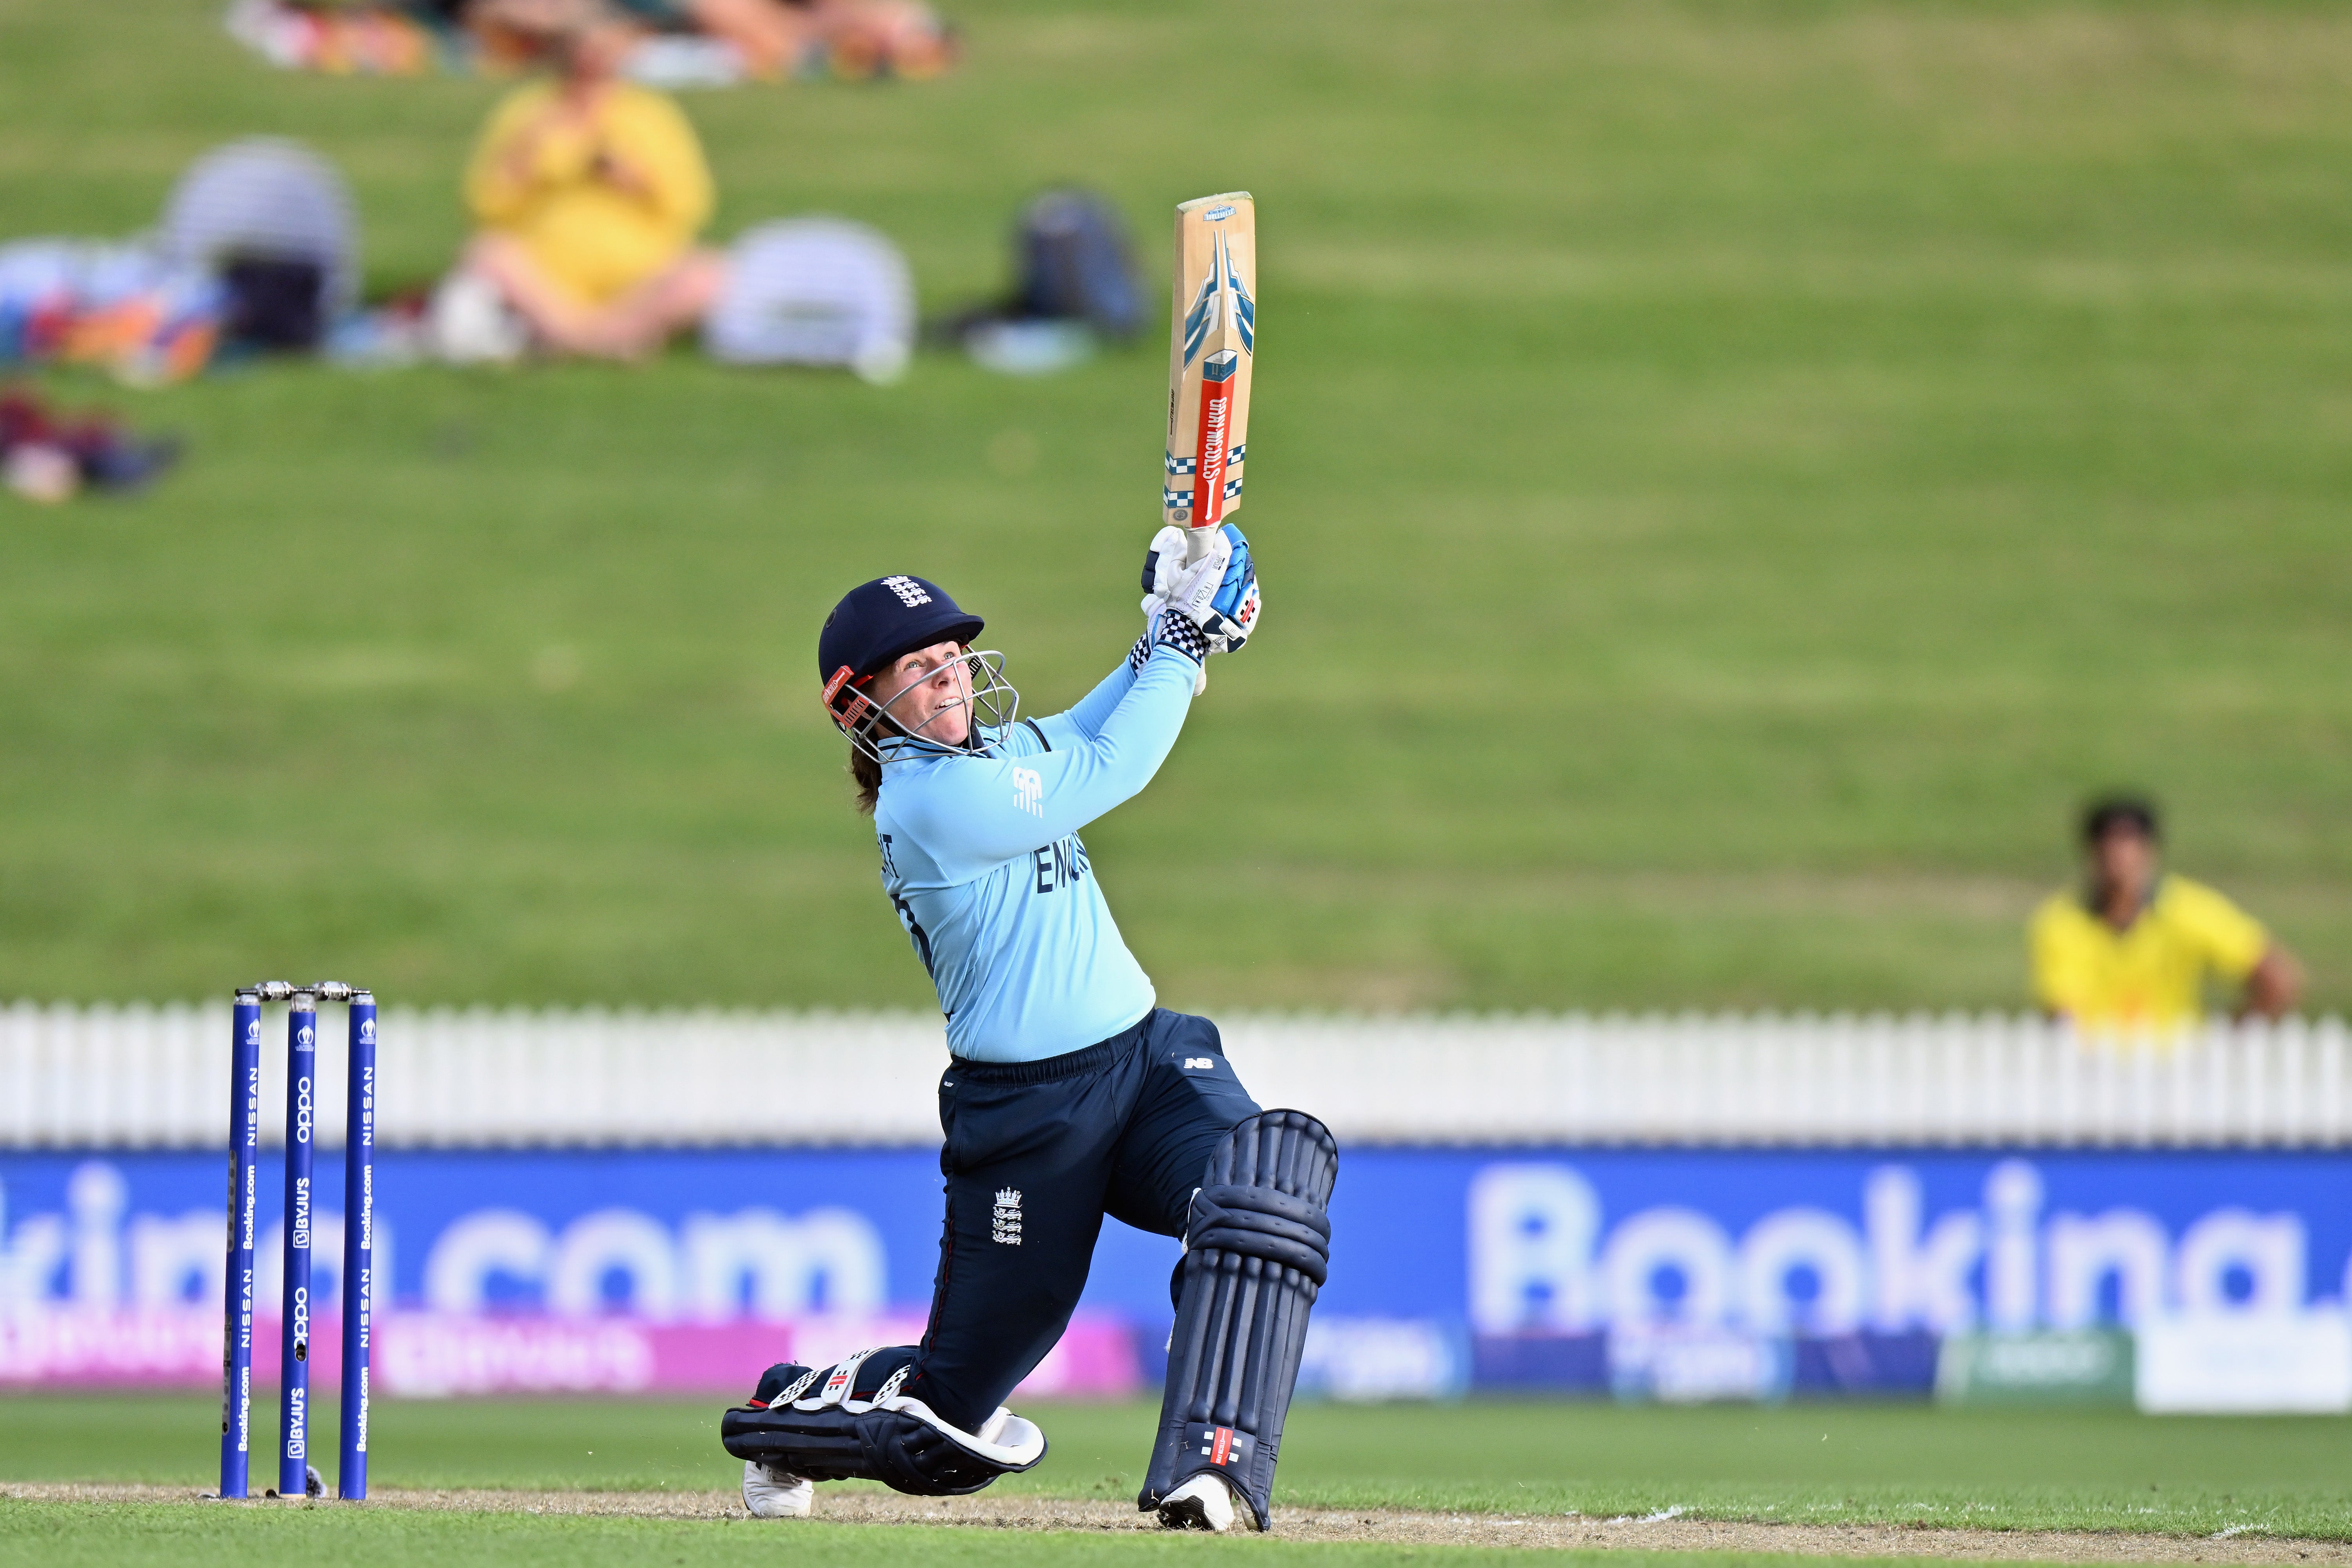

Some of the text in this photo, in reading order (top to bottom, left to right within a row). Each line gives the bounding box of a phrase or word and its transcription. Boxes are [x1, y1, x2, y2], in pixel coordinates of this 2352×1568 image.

[1202, 396, 1228, 479] GRAY-NICOLLS
[247, 1067, 258, 1146] NISSAN
[297, 1076, 312, 1143] oppo
[363, 1066, 373, 1146] NISSAN
[243, 1165, 255, 1250] Booking.com
[296, 1177, 310, 1229] BYJU'S
[360, 1165, 372, 1250] Booking.com
[241, 1269, 252, 1348] NISSAN
[360, 1269, 370, 1348] NISSAN
[238, 1366, 250, 1452] Booking.com
[290, 1387, 305, 1439] BYJU'S
[357, 1366, 368, 1452] Booking.com
[1215, 1439, 1226, 1464] GRAY-NICOLLS
